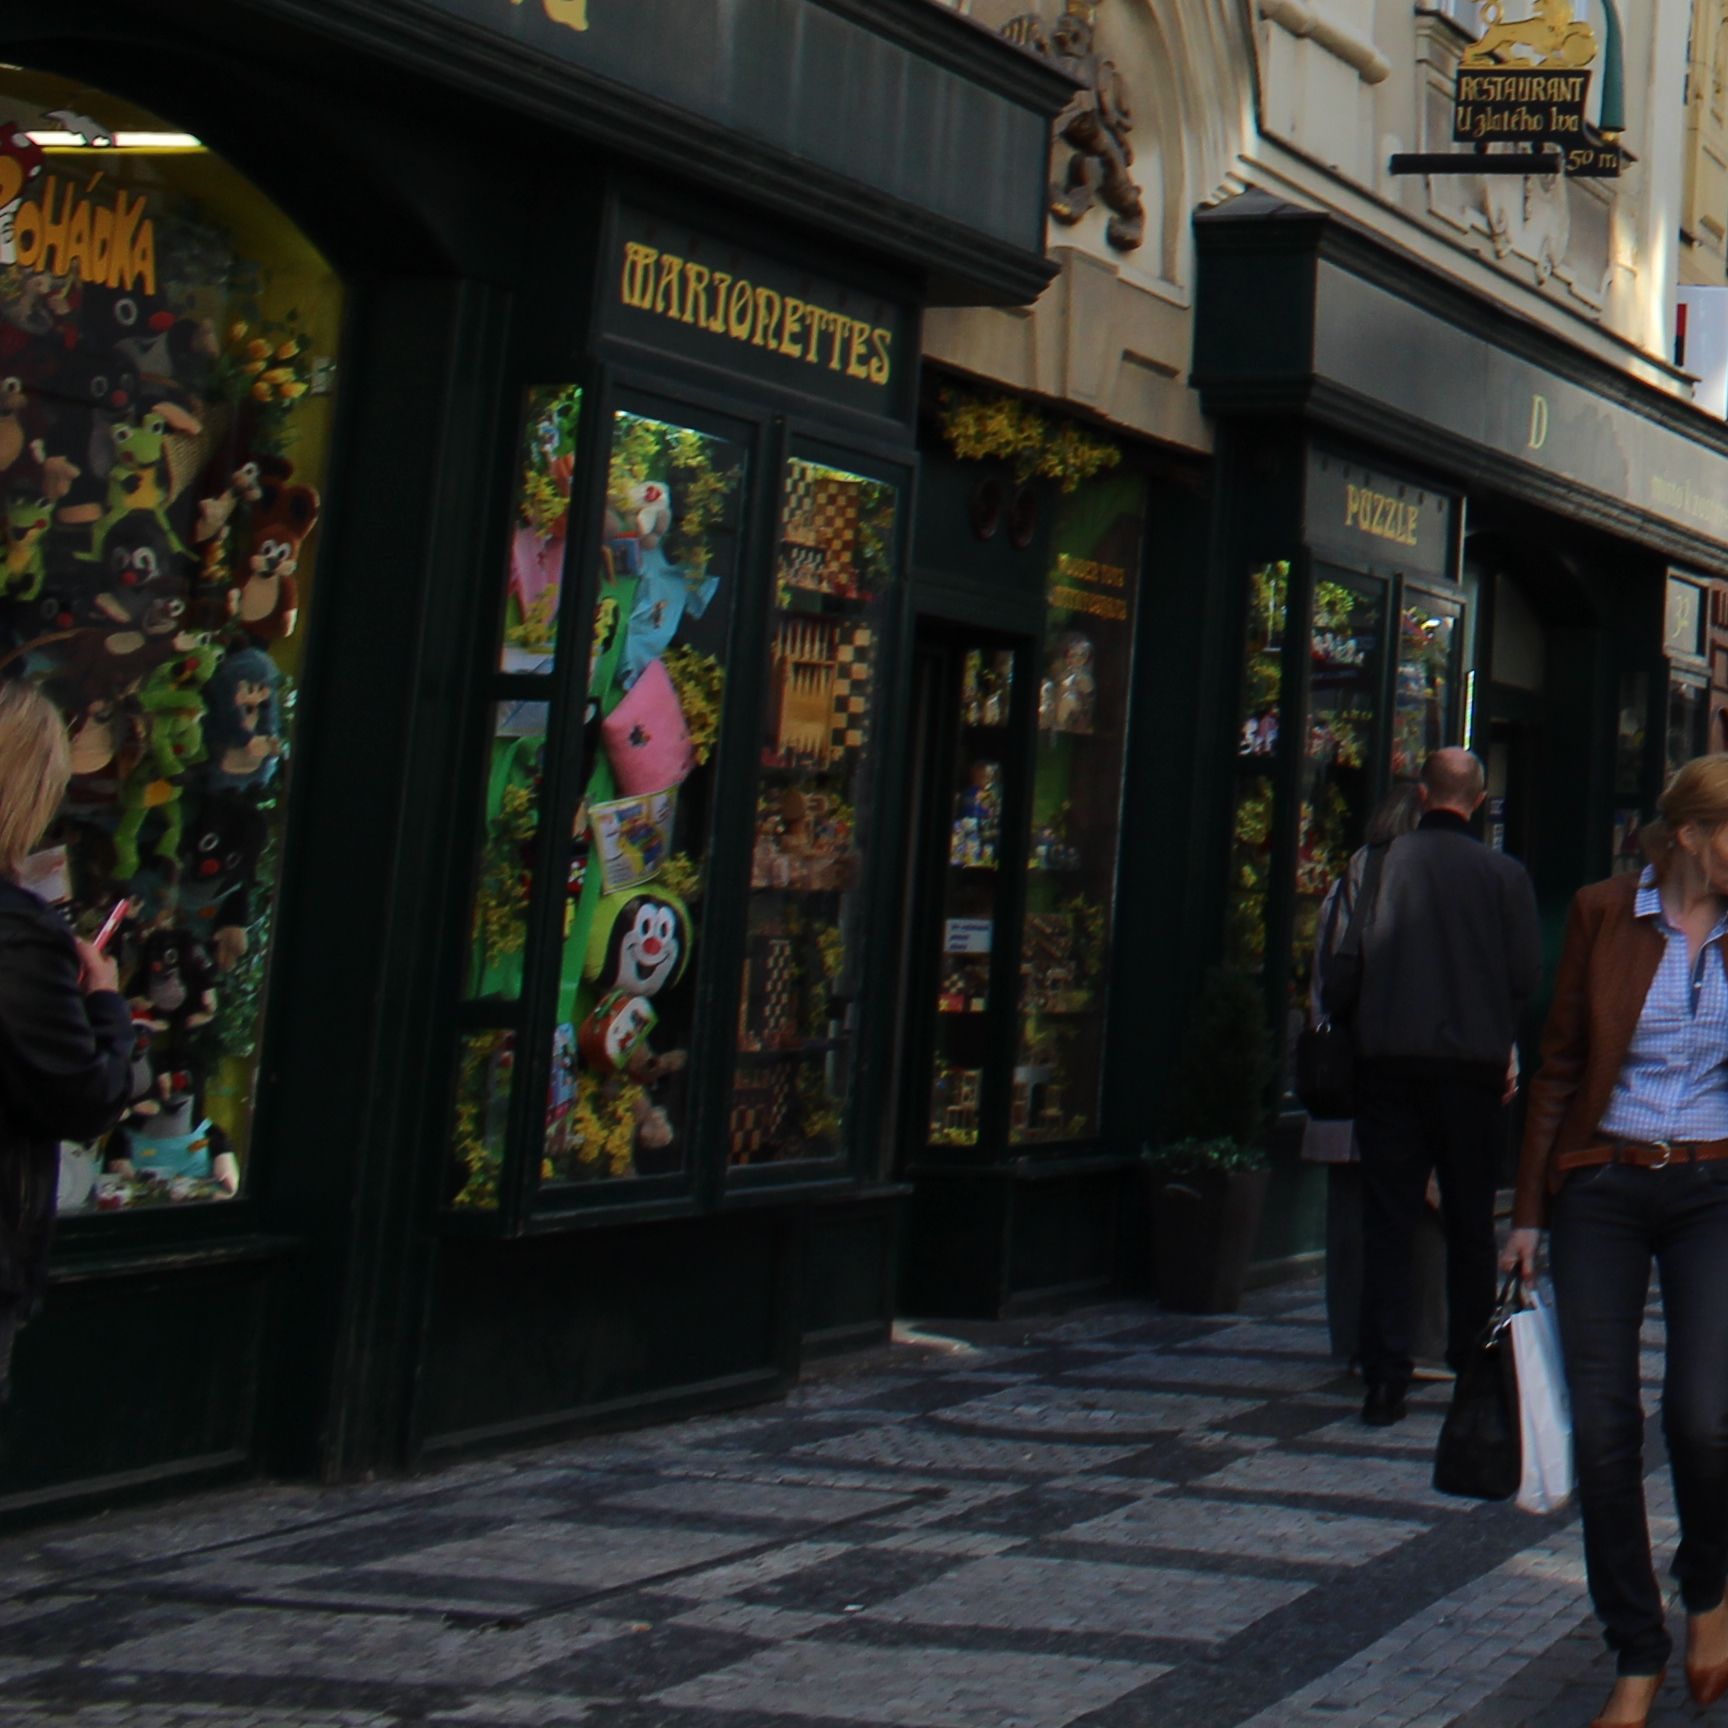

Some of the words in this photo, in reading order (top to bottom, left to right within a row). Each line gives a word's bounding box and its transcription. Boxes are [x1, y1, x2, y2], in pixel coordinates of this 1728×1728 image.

[1459, 75, 1585, 103] RESTAURANT
[1457, 105, 1472, 131] U
[1567, 149, 1595, 171] 50
[1598, 152, 1618, 169] m
[618, 240, 893, 386] MARIONETTES
[1344, 483, 1419, 547] PUZZLE
